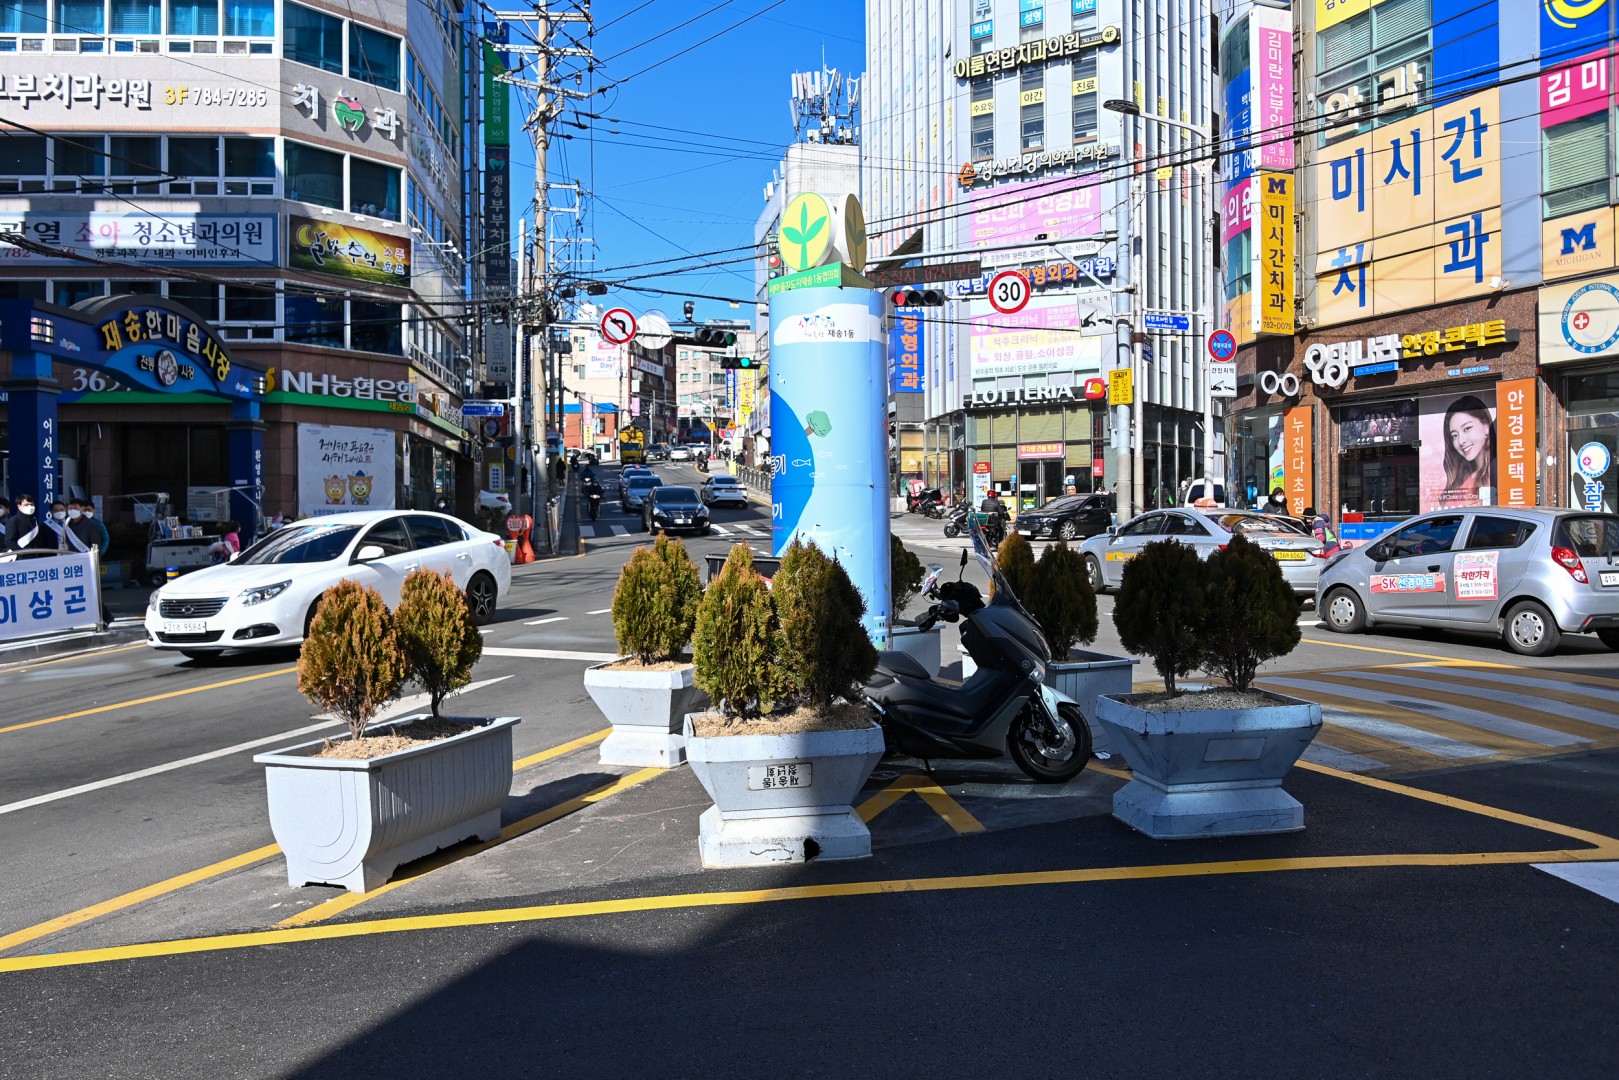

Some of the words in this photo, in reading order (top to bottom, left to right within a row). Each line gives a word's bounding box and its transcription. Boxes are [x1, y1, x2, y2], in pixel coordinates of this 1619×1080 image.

[1023, 11, 1042, 24] 성형
[974, 22, 992, 35] 피부
[1104, 29, 1115, 39] 4F
[1076, 79, 1095, 92] 진료
[164, 86, 189, 105] 3F
[193, 86, 267, 107] 784-7285
[1023, 91, 1042, 103] 야간
[973, 101, 994, 113] 수요일
[1329, 107, 1488, 213] 미시간
[1268, 177, 1287, 195] M
[489, 175, 506, 258] 재송부부치과
[75, 221, 120, 246] 소아
[133, 221, 262, 246] 청소년과의원
[1560, 222, 1597, 256] M
[154, 248, 175, 258] 내과
[186, 248, 241, 259] 이비인후과
[384, 247, 405, 260] 소주
[1269, 205, 1286, 313] 미시간치과
[1331, 212, 1490, 309] 치과
[1556, 251, 1602, 267] MICHIGAN
[998, 281, 1021, 303] 30
[827, 329, 855, 339] 재송1동
[1263, 321, 1291, 331] 782-0075
[900, 314, 919, 390] 정형외과
[282, 370, 417, 403] NH농협은행
[972, 384, 1075, 405] LOTTERIA
[1507, 389, 1525, 506] 안경콘택트
[1291, 416, 1305, 514] 누진다초점
[63, 564, 84, 579] 의원
[1461, 570, 1490, 581] 착한가격
[1382, 577, 1397, 589] SK
[1398, 575, 1435, 590] 선경마트
[0, 585, 86, 625] 이상곤
[766, 764, 797, 777] 청년회
[762, 776, 799, 789] 재송1동
